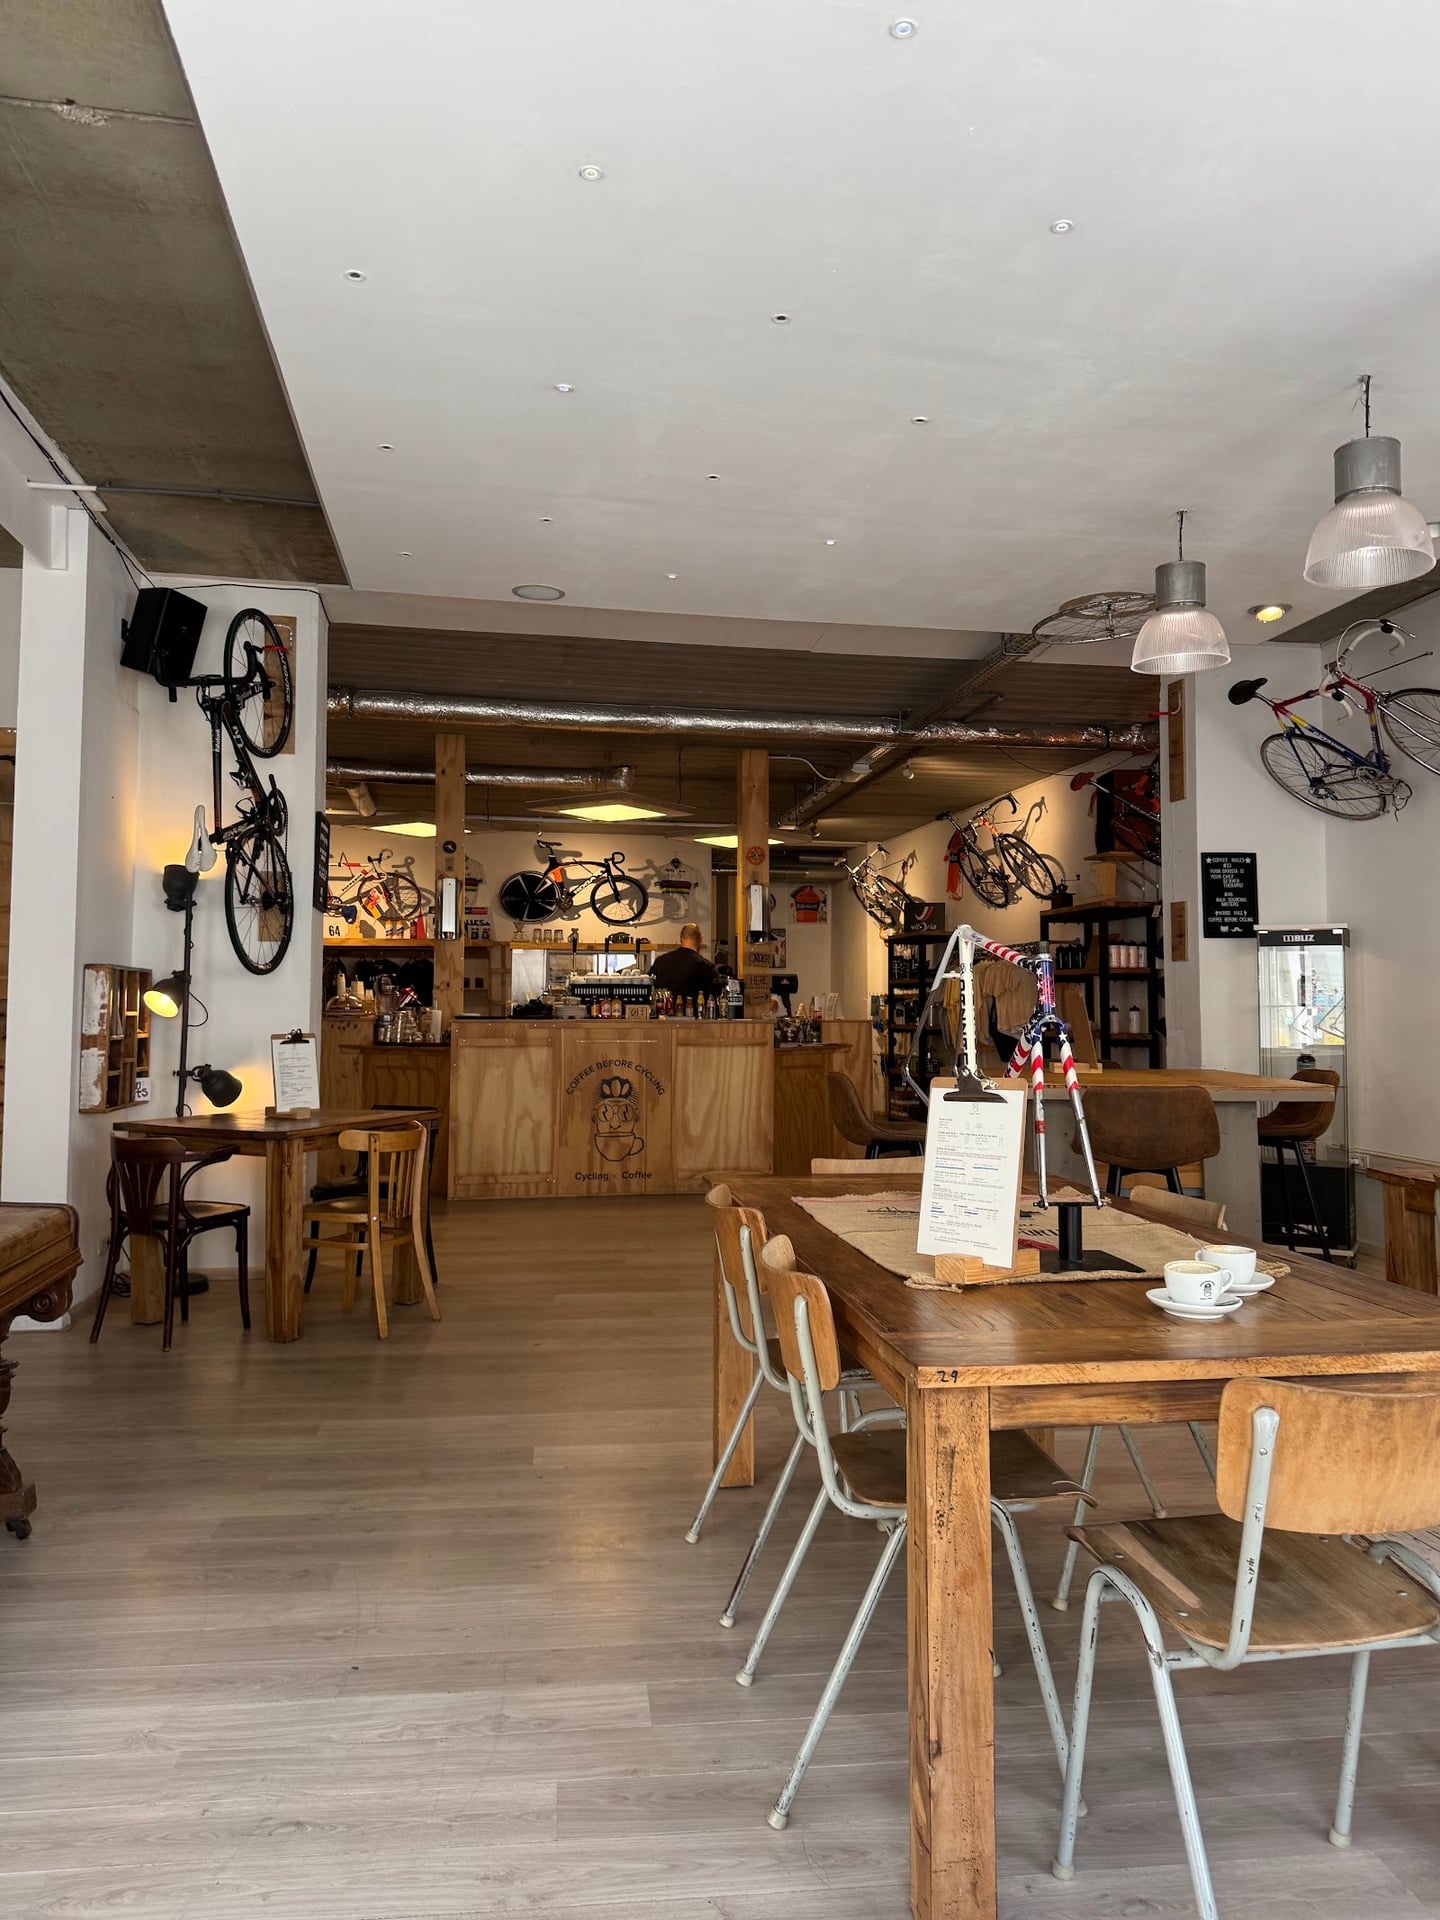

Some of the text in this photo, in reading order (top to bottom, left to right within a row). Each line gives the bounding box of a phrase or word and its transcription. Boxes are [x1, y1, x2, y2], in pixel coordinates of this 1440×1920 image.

[329, 925, 341, 937] 64
[566, 1059, 665, 1096] COFFEE BEFORE CYCLING
[574, 1170, 653, 1181] Cycling Coffee
[936, 1370, 958, 1383] 29
